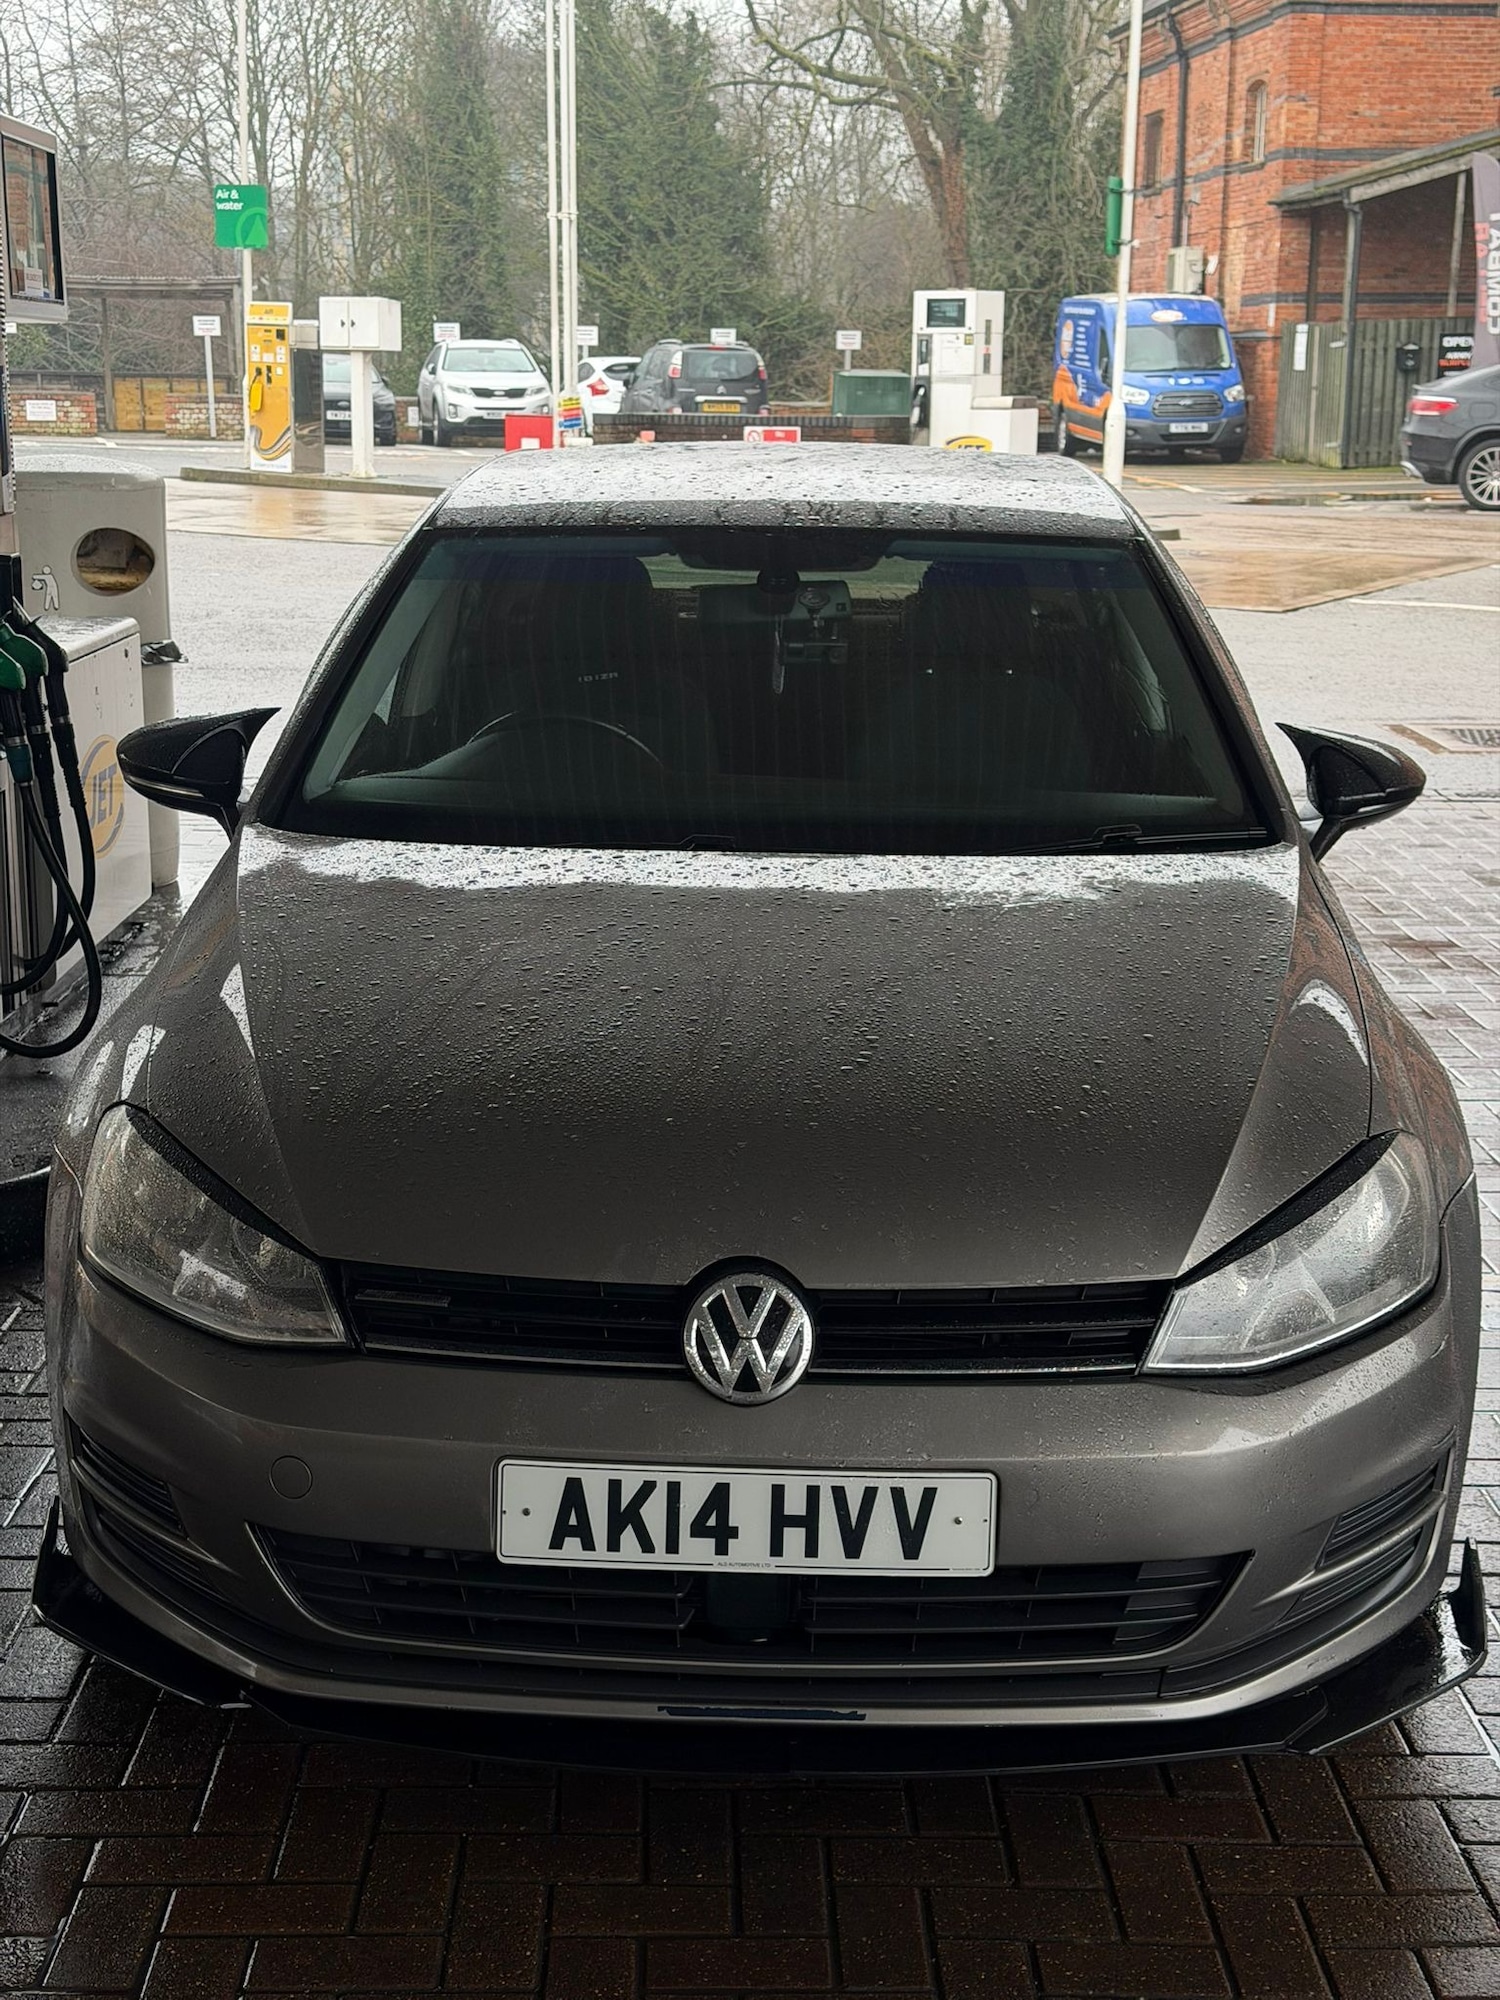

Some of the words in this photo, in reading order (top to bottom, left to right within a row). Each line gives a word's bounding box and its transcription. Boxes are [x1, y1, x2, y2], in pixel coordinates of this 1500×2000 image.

[216, 189, 229, 199] Air
[230, 189, 239, 199] &
[216, 201, 244, 210] water
[89, 761, 118, 829] JET
[548, 1477, 739, 1556] AK14
[769, 1483, 939, 1560] HVV
